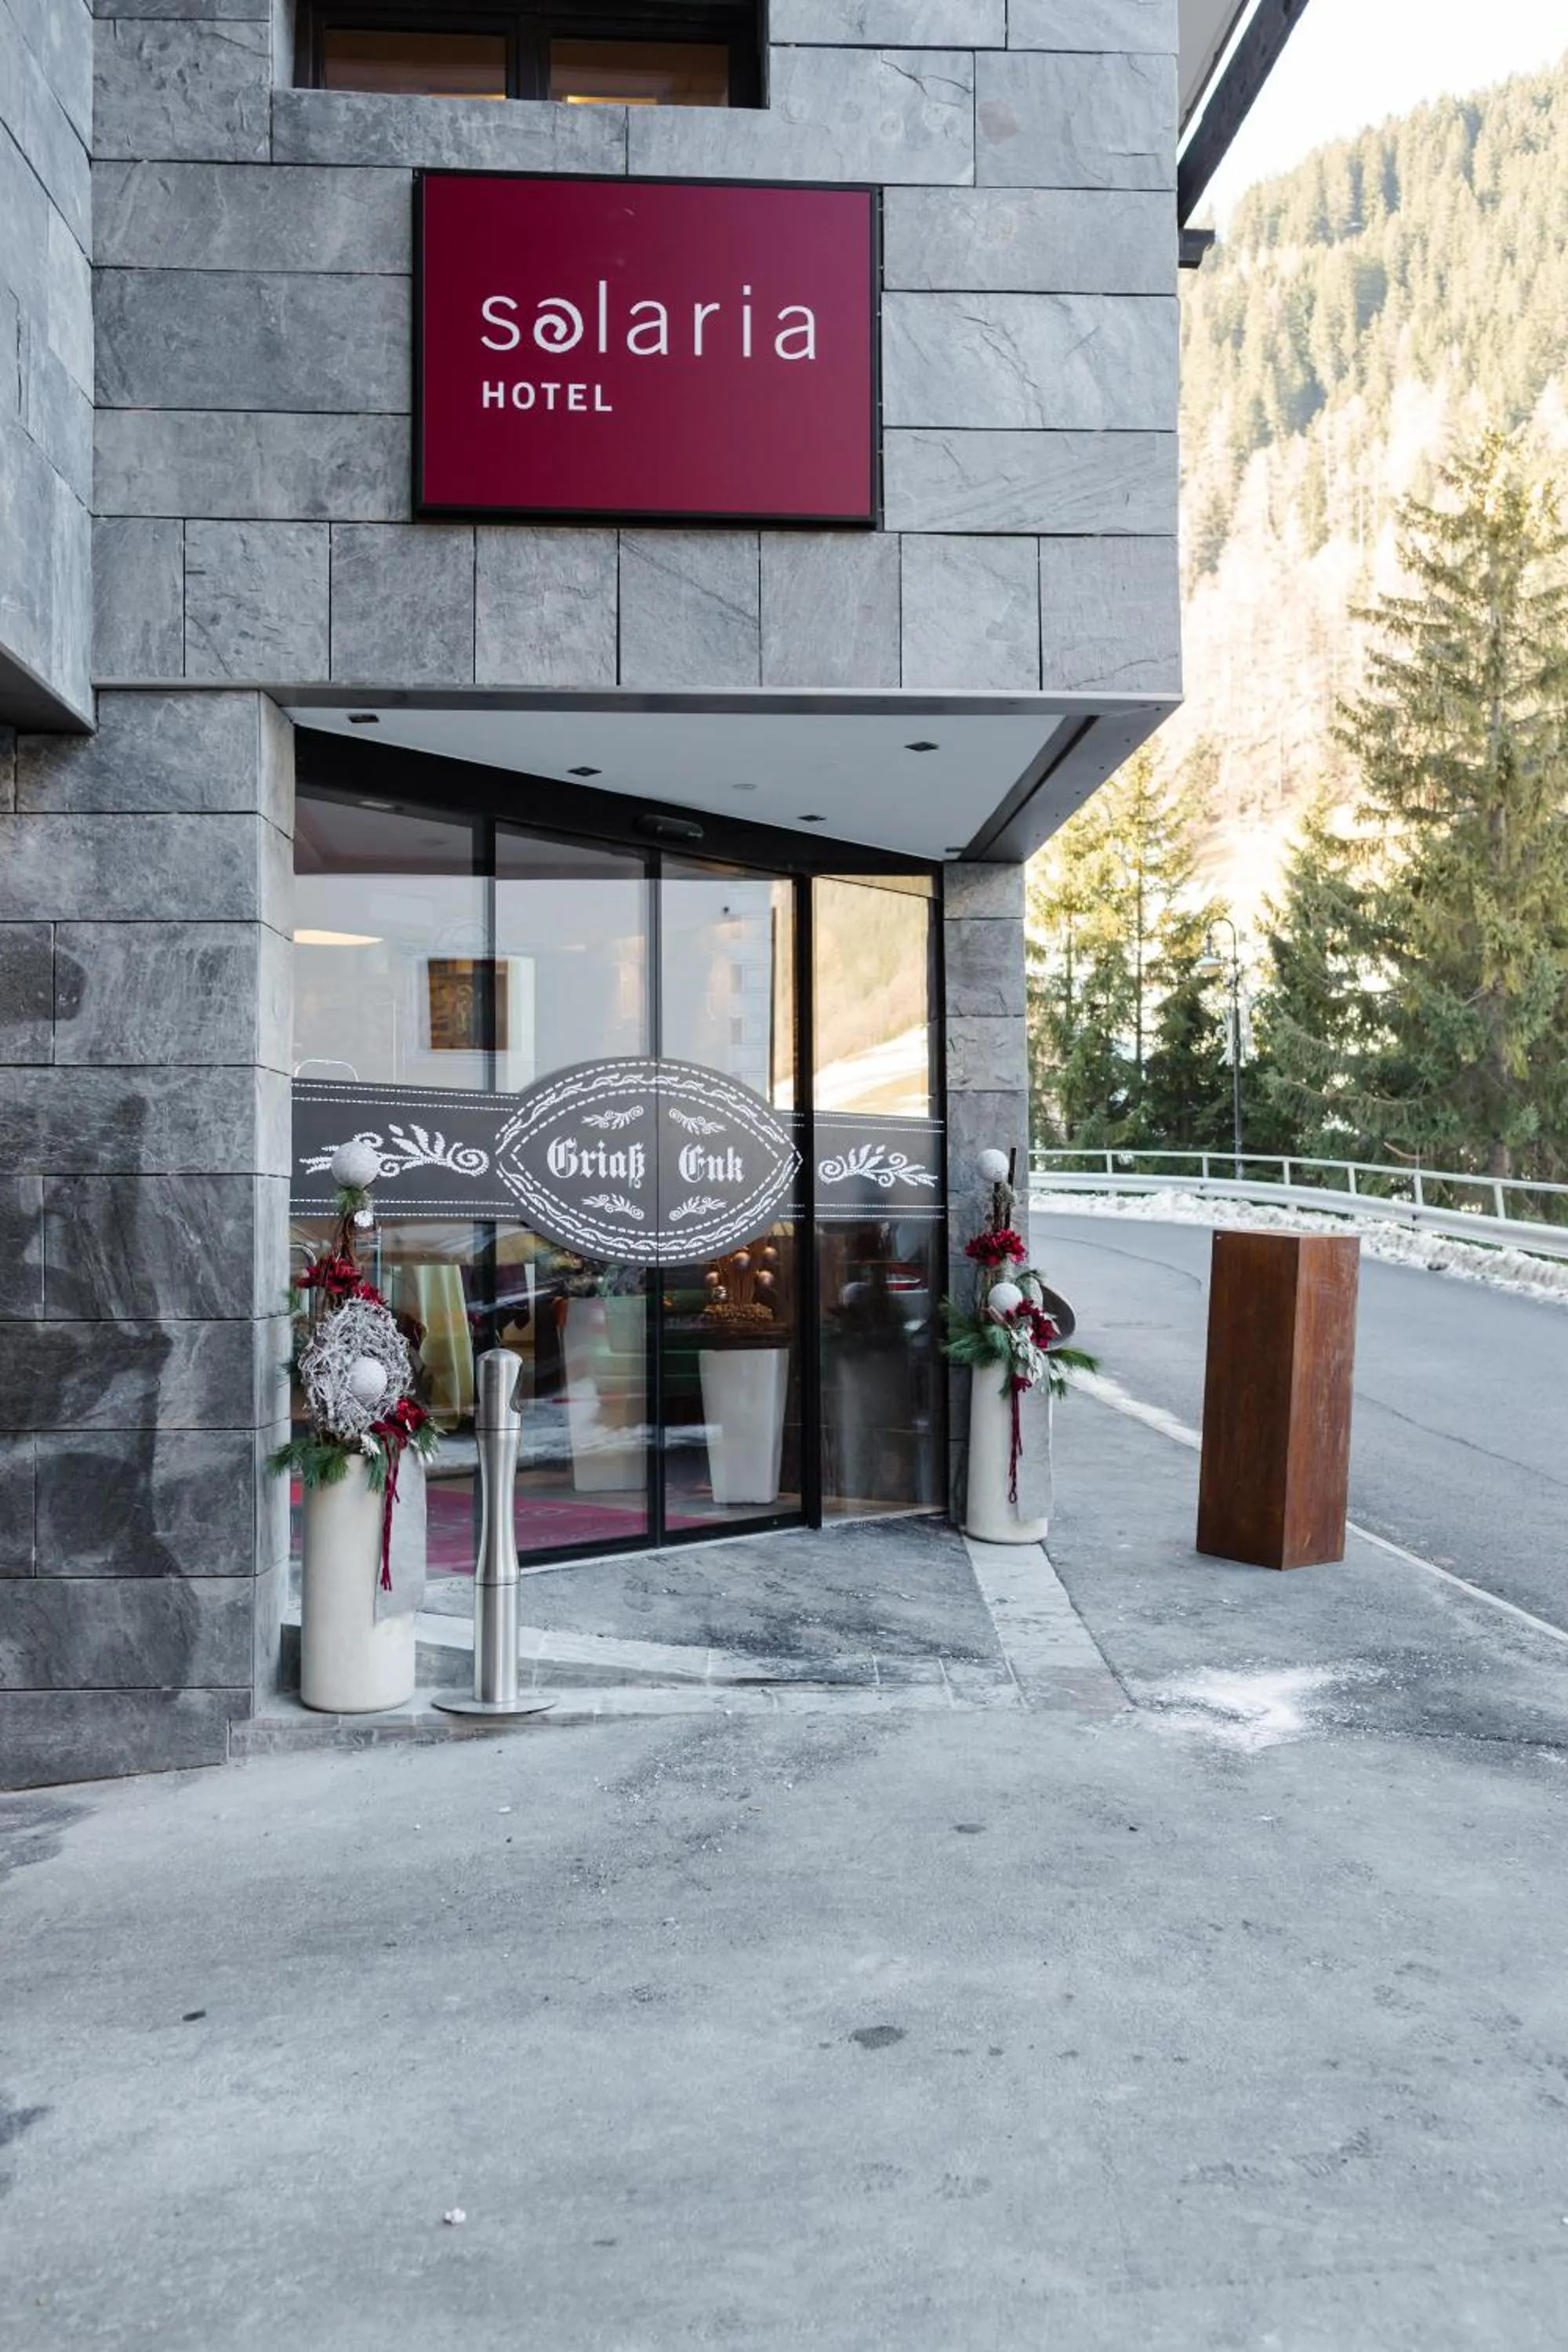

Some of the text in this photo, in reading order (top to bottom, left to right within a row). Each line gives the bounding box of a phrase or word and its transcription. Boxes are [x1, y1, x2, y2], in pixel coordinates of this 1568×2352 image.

[481, 280, 816, 361] solaria
[481, 381, 613, 412] HOTEL
[546, 1136, 646, 1189] Griaß
